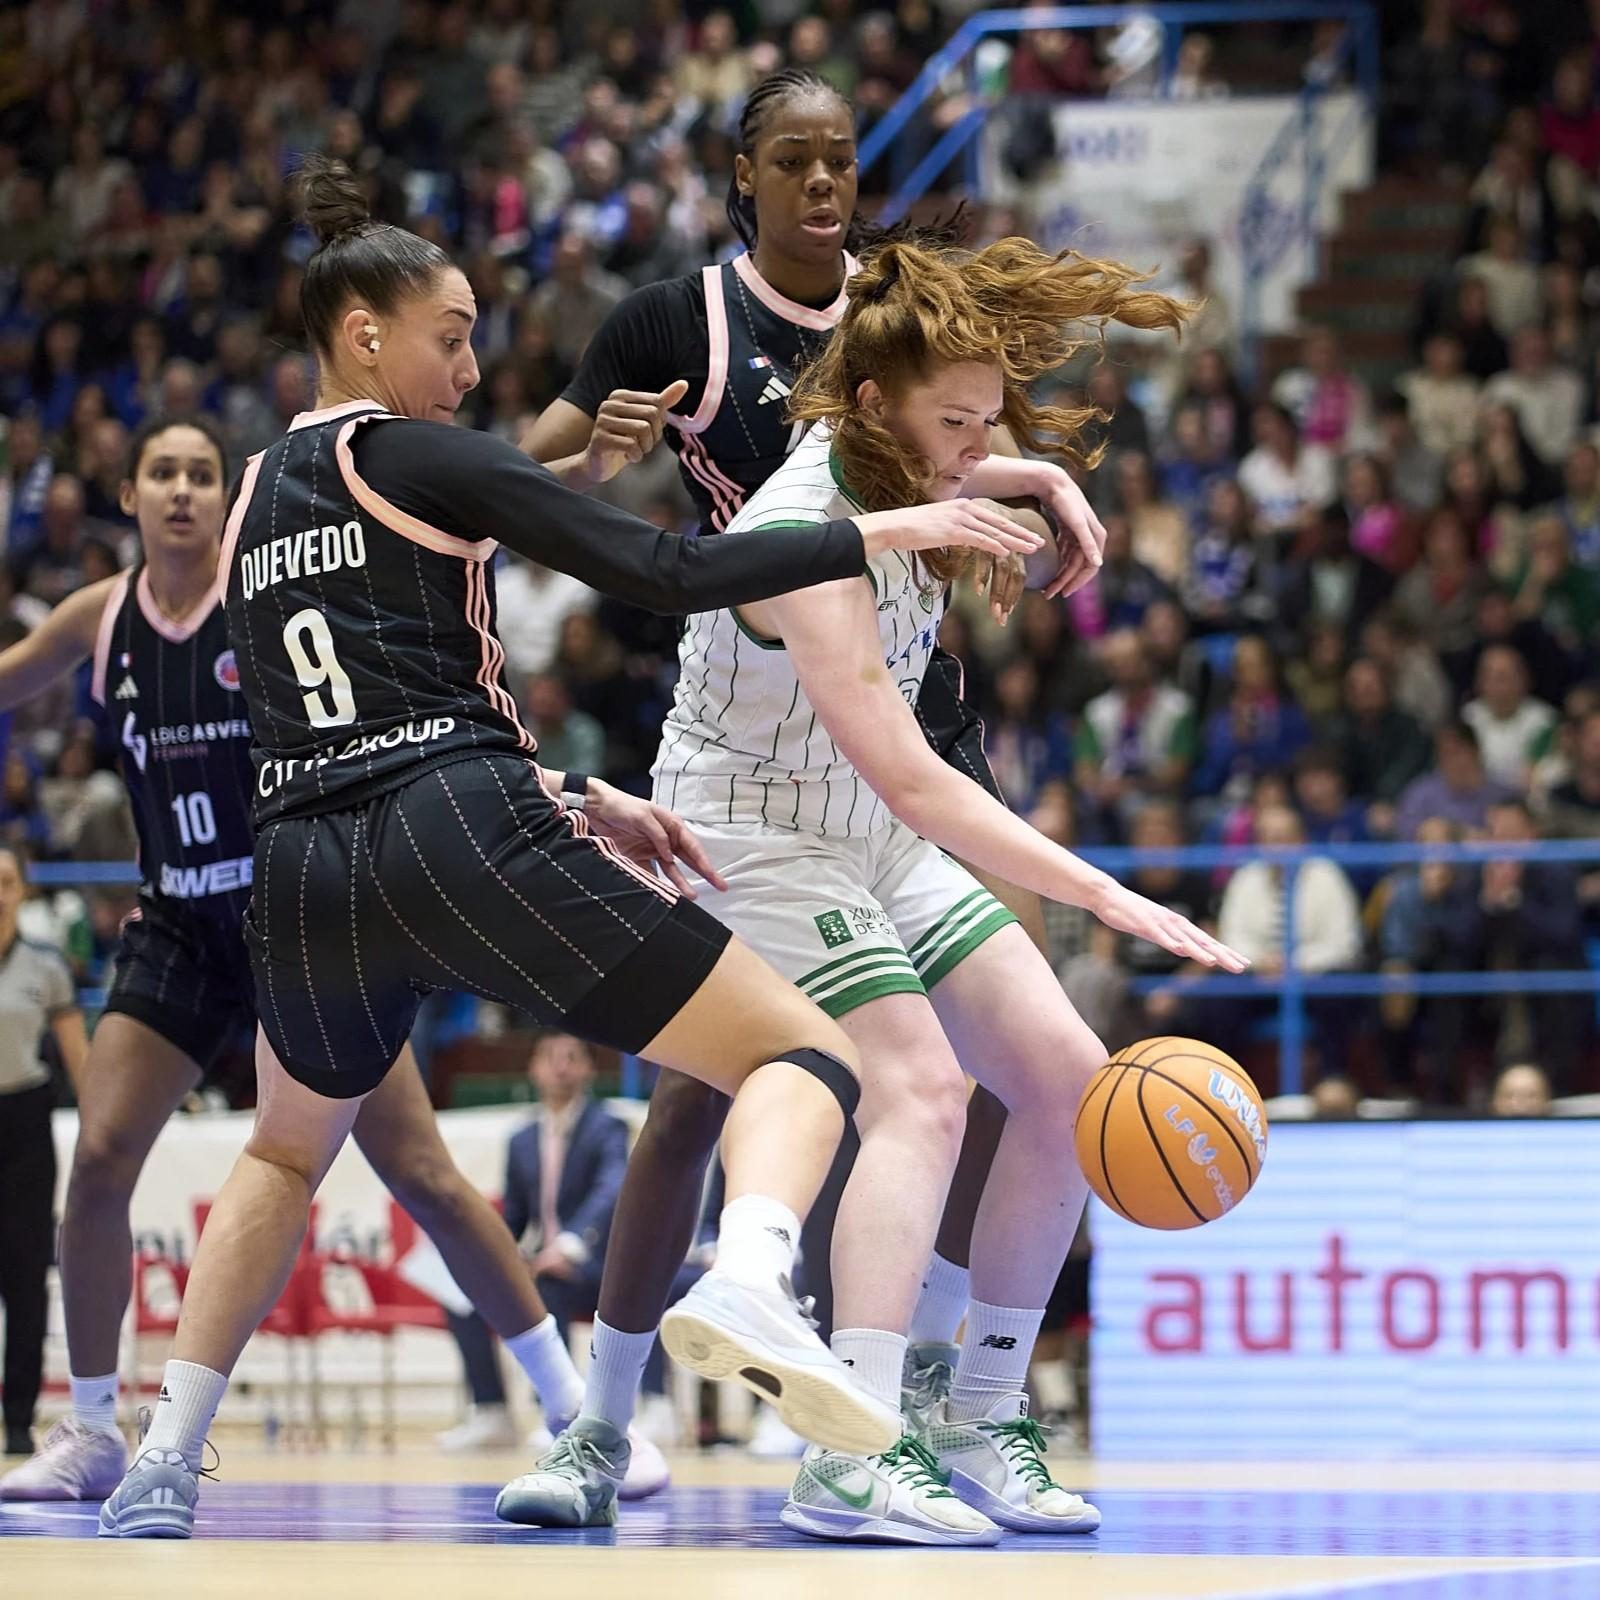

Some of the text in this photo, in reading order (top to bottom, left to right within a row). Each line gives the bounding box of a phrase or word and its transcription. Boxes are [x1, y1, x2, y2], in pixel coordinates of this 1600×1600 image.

[241, 521, 366, 600] QUEVEDO
[283, 608, 357, 728] 9
[171, 791, 217, 846] 10
[848, 907, 891, 922] XUNT
[855, 922, 878, 935] DE
[1145, 1235, 1600, 1352] autom
